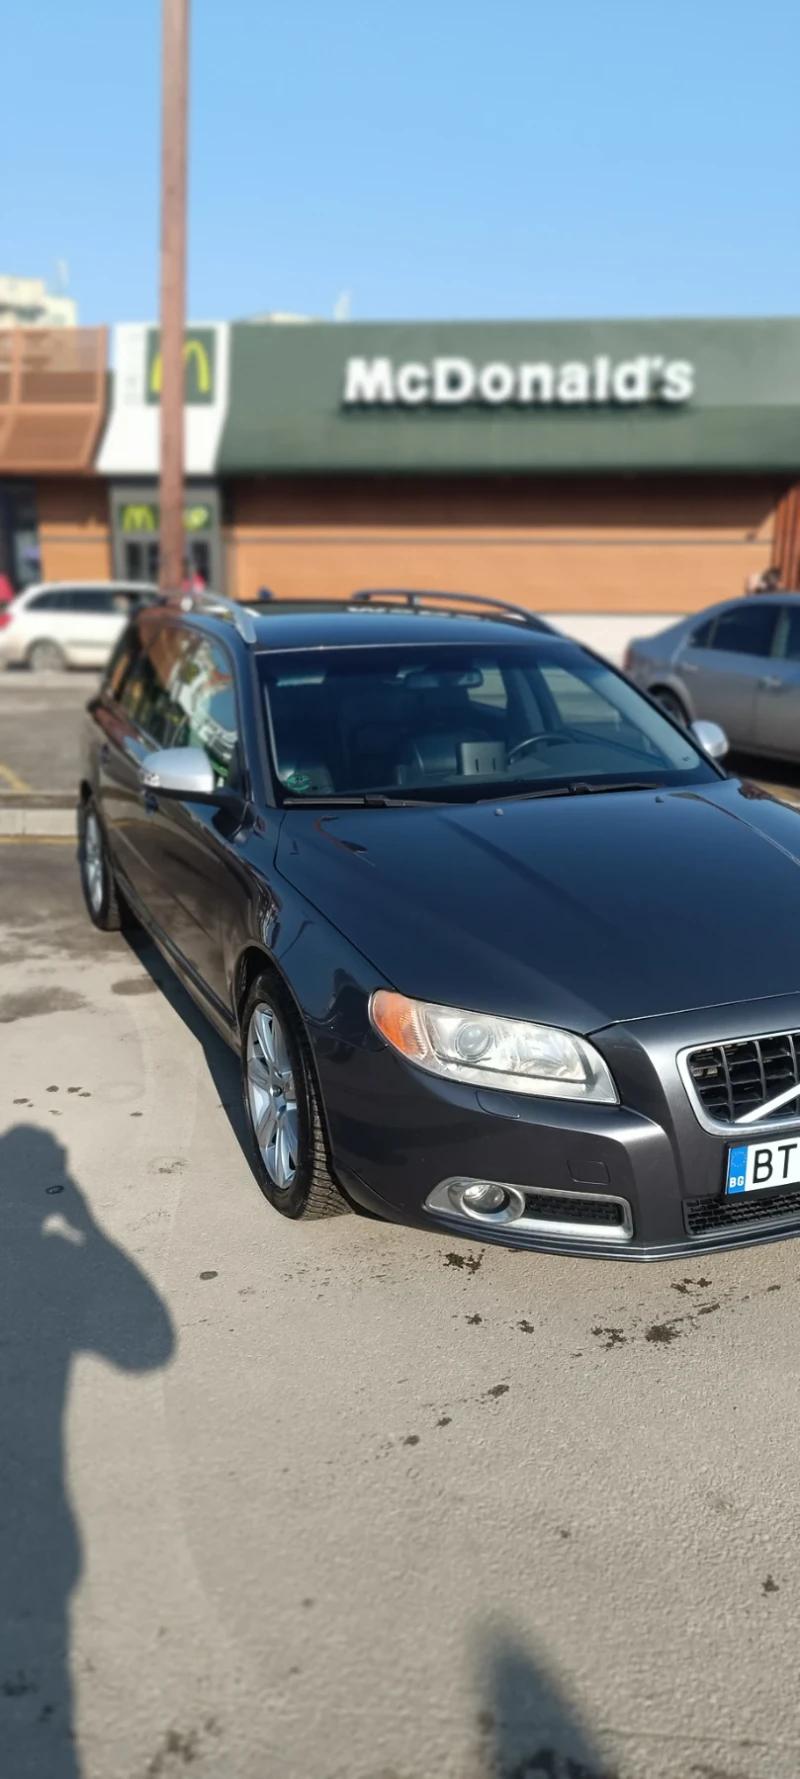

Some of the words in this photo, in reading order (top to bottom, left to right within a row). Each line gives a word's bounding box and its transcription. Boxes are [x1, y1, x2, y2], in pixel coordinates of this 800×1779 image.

[344, 355, 694, 401] McDonald's
[729, 1175, 745, 1188] BG
[752, 1143, 798, 1184] BT
